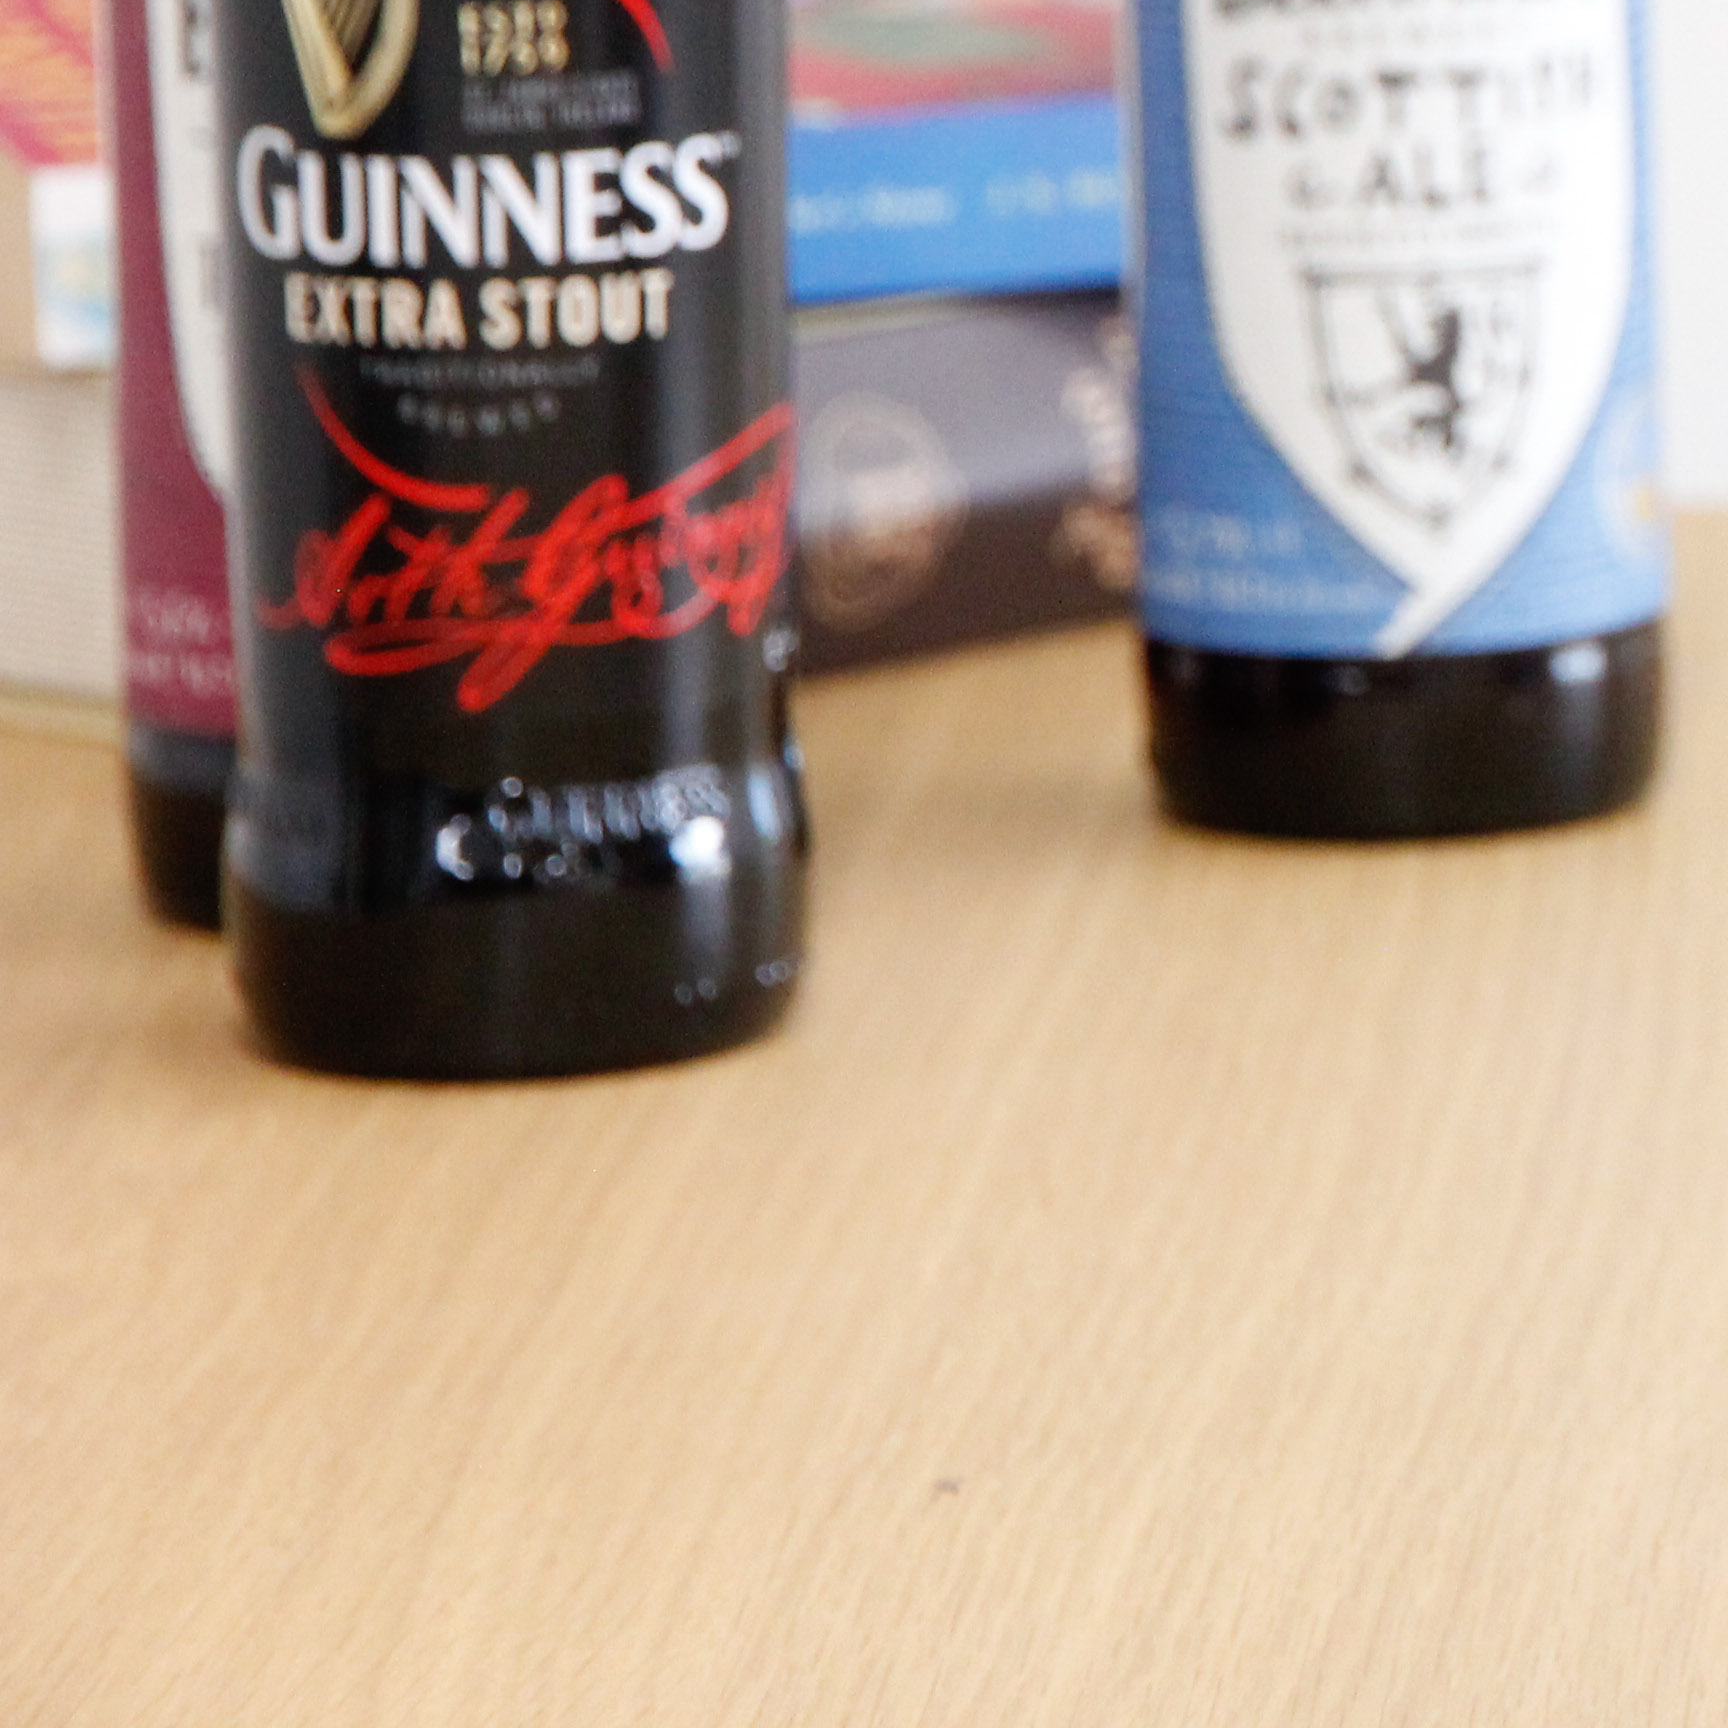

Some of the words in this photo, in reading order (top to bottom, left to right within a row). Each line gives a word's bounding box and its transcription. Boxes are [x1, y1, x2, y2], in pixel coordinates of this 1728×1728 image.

[237, 125, 730, 269] GUINNESS
[1352, 128, 1494, 211] ALE
[284, 271, 467, 352] EXTRA
[477, 267, 674, 351] STOUT
